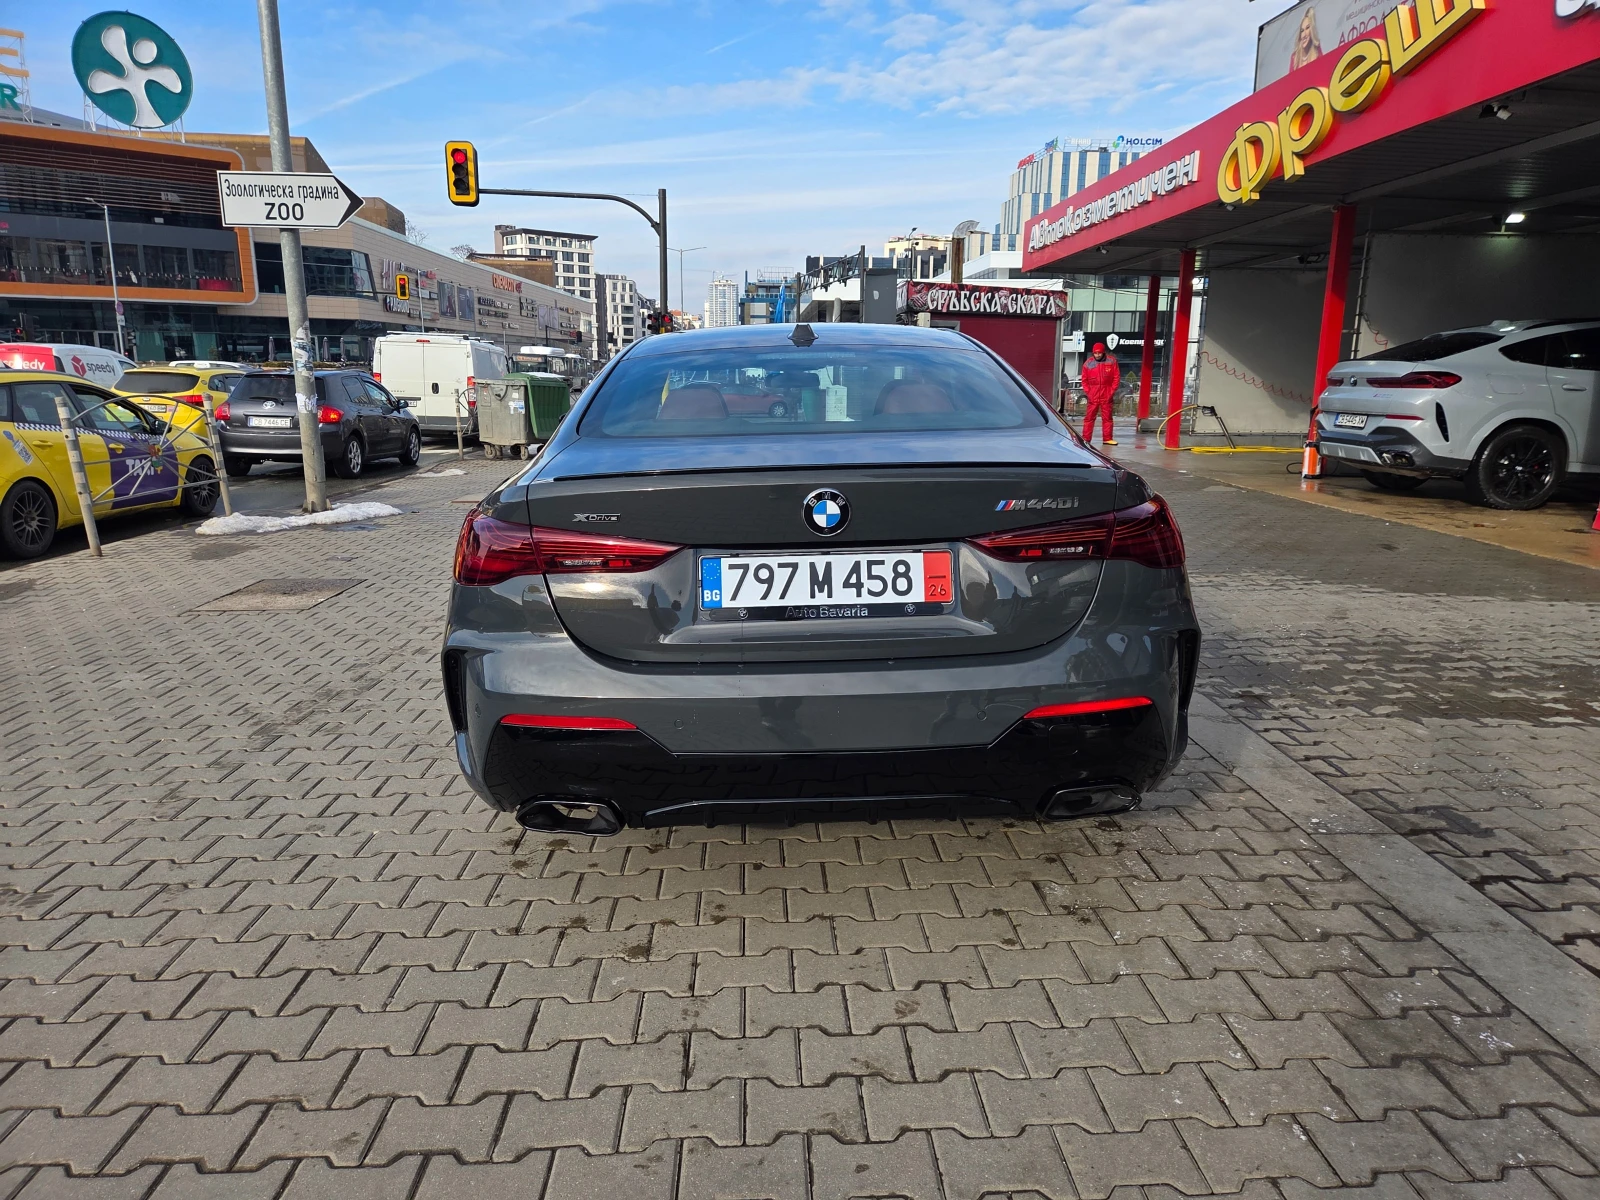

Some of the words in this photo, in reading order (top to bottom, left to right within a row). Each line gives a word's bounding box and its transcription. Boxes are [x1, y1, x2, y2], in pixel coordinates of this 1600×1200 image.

[1126, 138, 1163, 146] HOLCIM
[224, 178, 294, 198] Зоологическа
[298, 185, 339, 203] градина
[1028, 150, 1201, 252] Автокозметичен
[264, 202, 304, 221] ZOO
[927, 289, 1001, 313] СРЪБСКА
[1007, 293, 1056, 315] СКАРА
[86, 361, 116, 376] speedy
[808, 491, 846, 508] BMW
[728, 562, 799, 602] 797
[808, 560, 833, 599] M
[842, 559, 913, 598] 458
[703, 589, 721, 602] BG
[928, 583, 947, 597] 26
[785, 606, 816, 618] Auto
[820, 604, 868, 617] Bavaria
